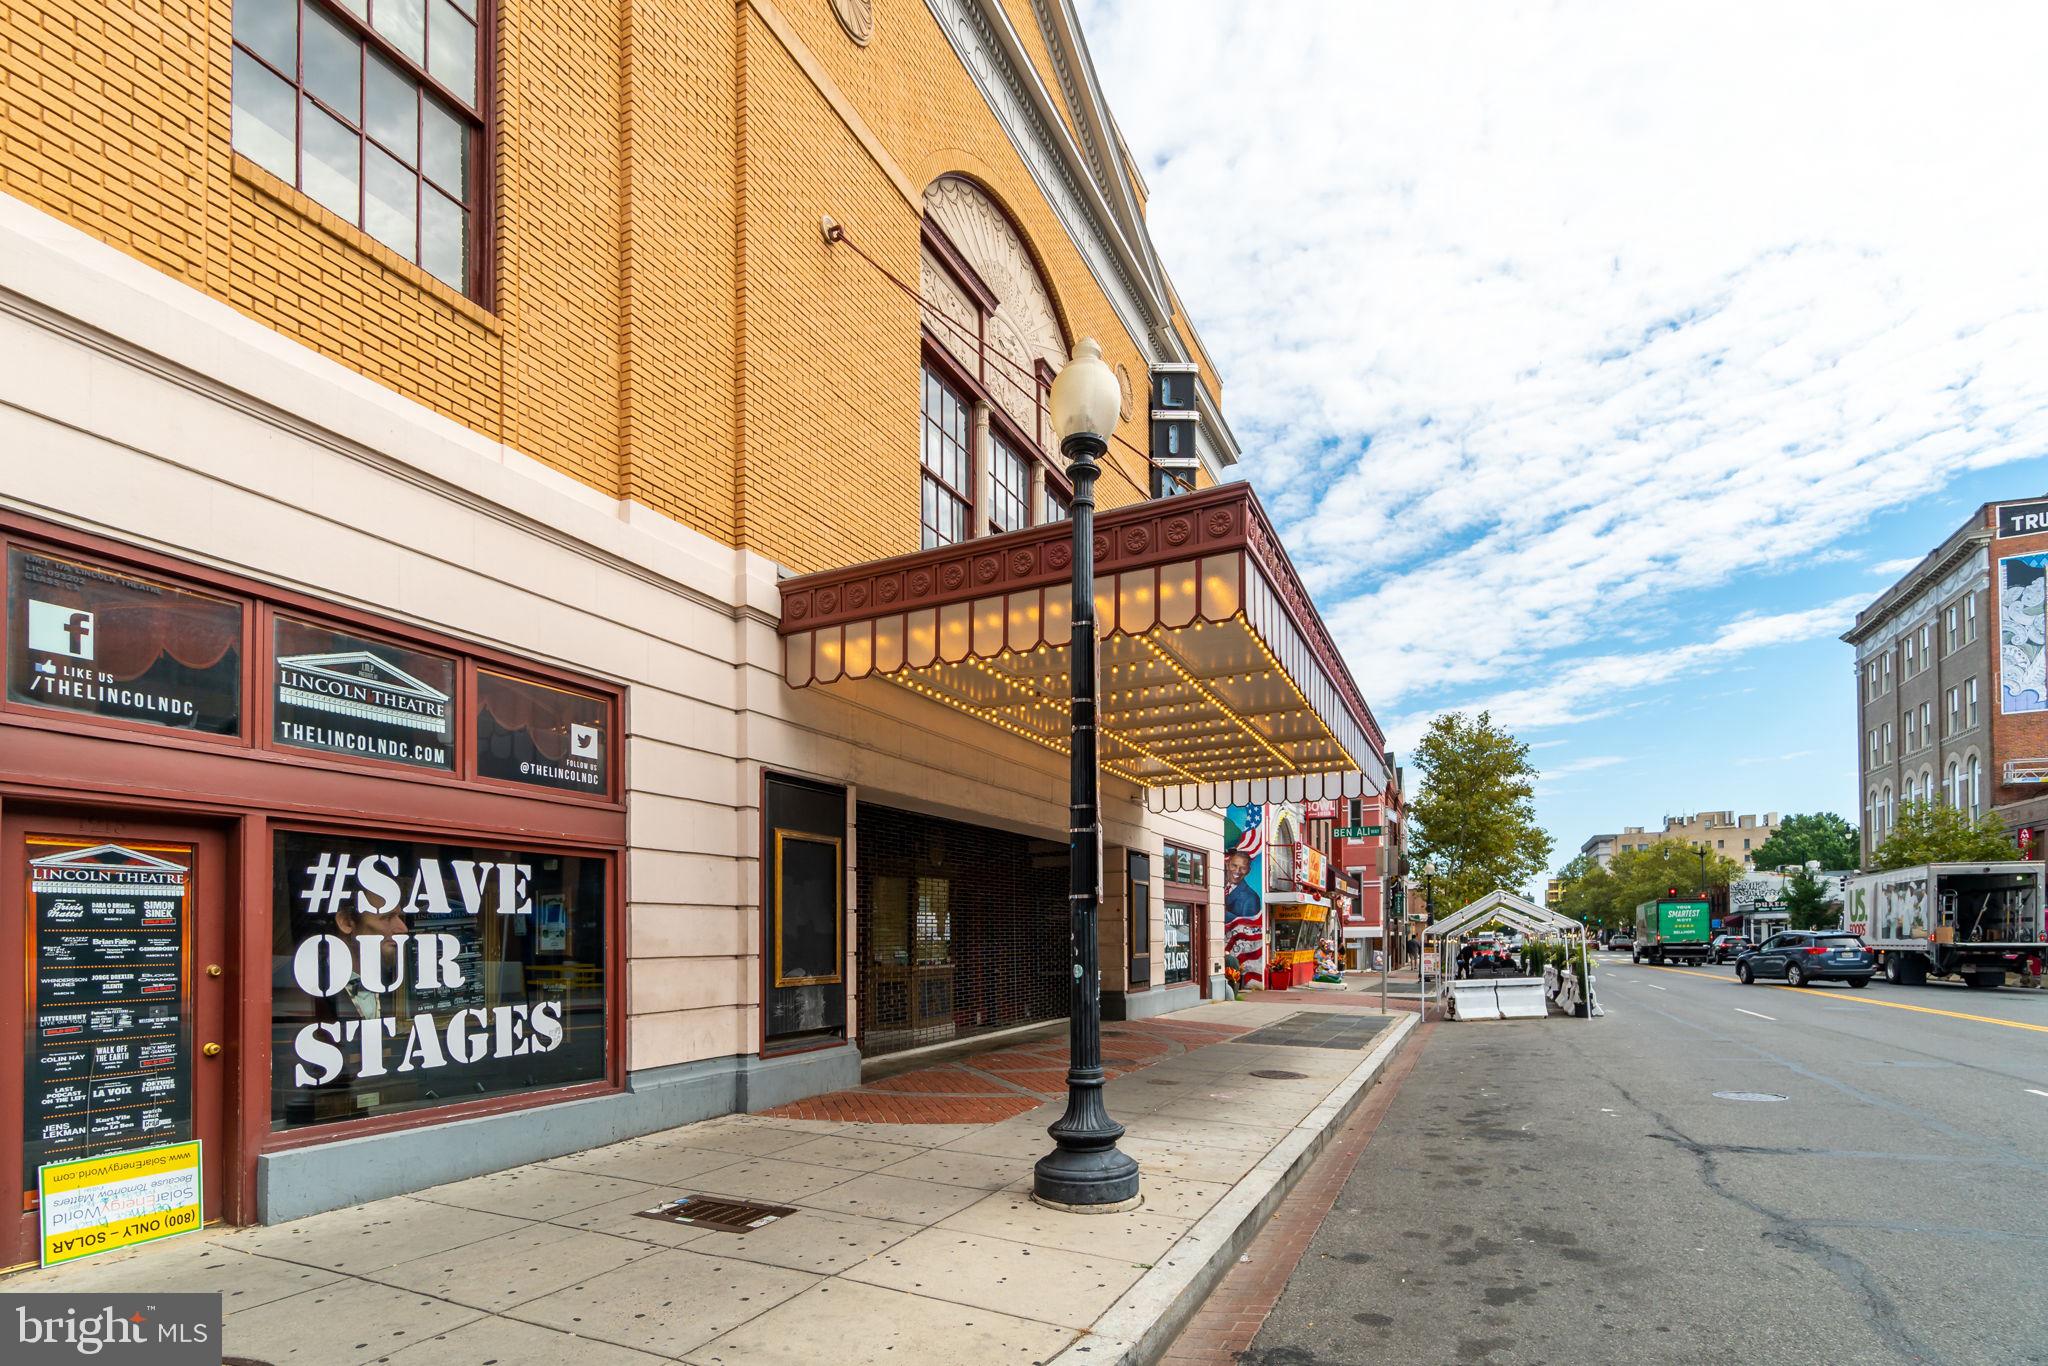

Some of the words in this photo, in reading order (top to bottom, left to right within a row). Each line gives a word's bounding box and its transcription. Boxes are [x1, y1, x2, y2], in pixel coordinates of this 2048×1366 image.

[2011, 512, 2048, 531] TRU
[63, 665, 93, 680] LIKE
[98, 672, 114, 684] US
[30, 674, 194, 716] /THELINCOLNDC
[280, 670, 367, 701] LINCOLN
[372, 690, 445, 717] THEATRE
[281, 721, 445, 764] THELINCOLNDC.COM
[566, 759, 588, 770] FOLLOW
[520, 762, 599, 785] @THELINCOLNDC
[1334, 829, 1352, 837] BEN
[1357, 828, 1370, 836] ALI
[33, 868, 111, 881] LINCOLN
[116, 871, 184, 884] THEATRE
[300, 852, 533, 915] #SAVE
[144, 901, 174, 910] SIMON
[145, 909, 172, 918] SINEK
[1667, 910, 1700, 918] SMARTEST
[293, 933, 466, 998] OUR
[40, 1014, 87, 1022] LETTERKENNY
[96, 1046, 114, 1054] WALK
[116, 1045, 129, 1053] OFF
[294, 1001, 563, 1088] STAGES
[41, 1056, 68, 1064] COLIN
[109, 1052, 130, 1061] EARTH
[142, 1079, 175, 1087] FORTUNE
[46, 1090, 82, 1099] PODCAST
[93, 1090, 106, 1098] LA
[108, 1087, 132, 1096] VOIX
[43, 1122, 70, 1133] JENS
[43, 1127, 86, 1139] LEKMAN
[53, 1152, 191, 1183] www.SolarEnergyWorld.com
[150, 1174, 193, 1188] Because
[97, 1183, 149, 1199] Tomorrow
[53, 1193, 94, 1208] Matters
[165, 1209, 195, 1228] (800)
[122, 1220, 160, 1239] ONLY
[53, 1231, 107, 1254] SOLAR
